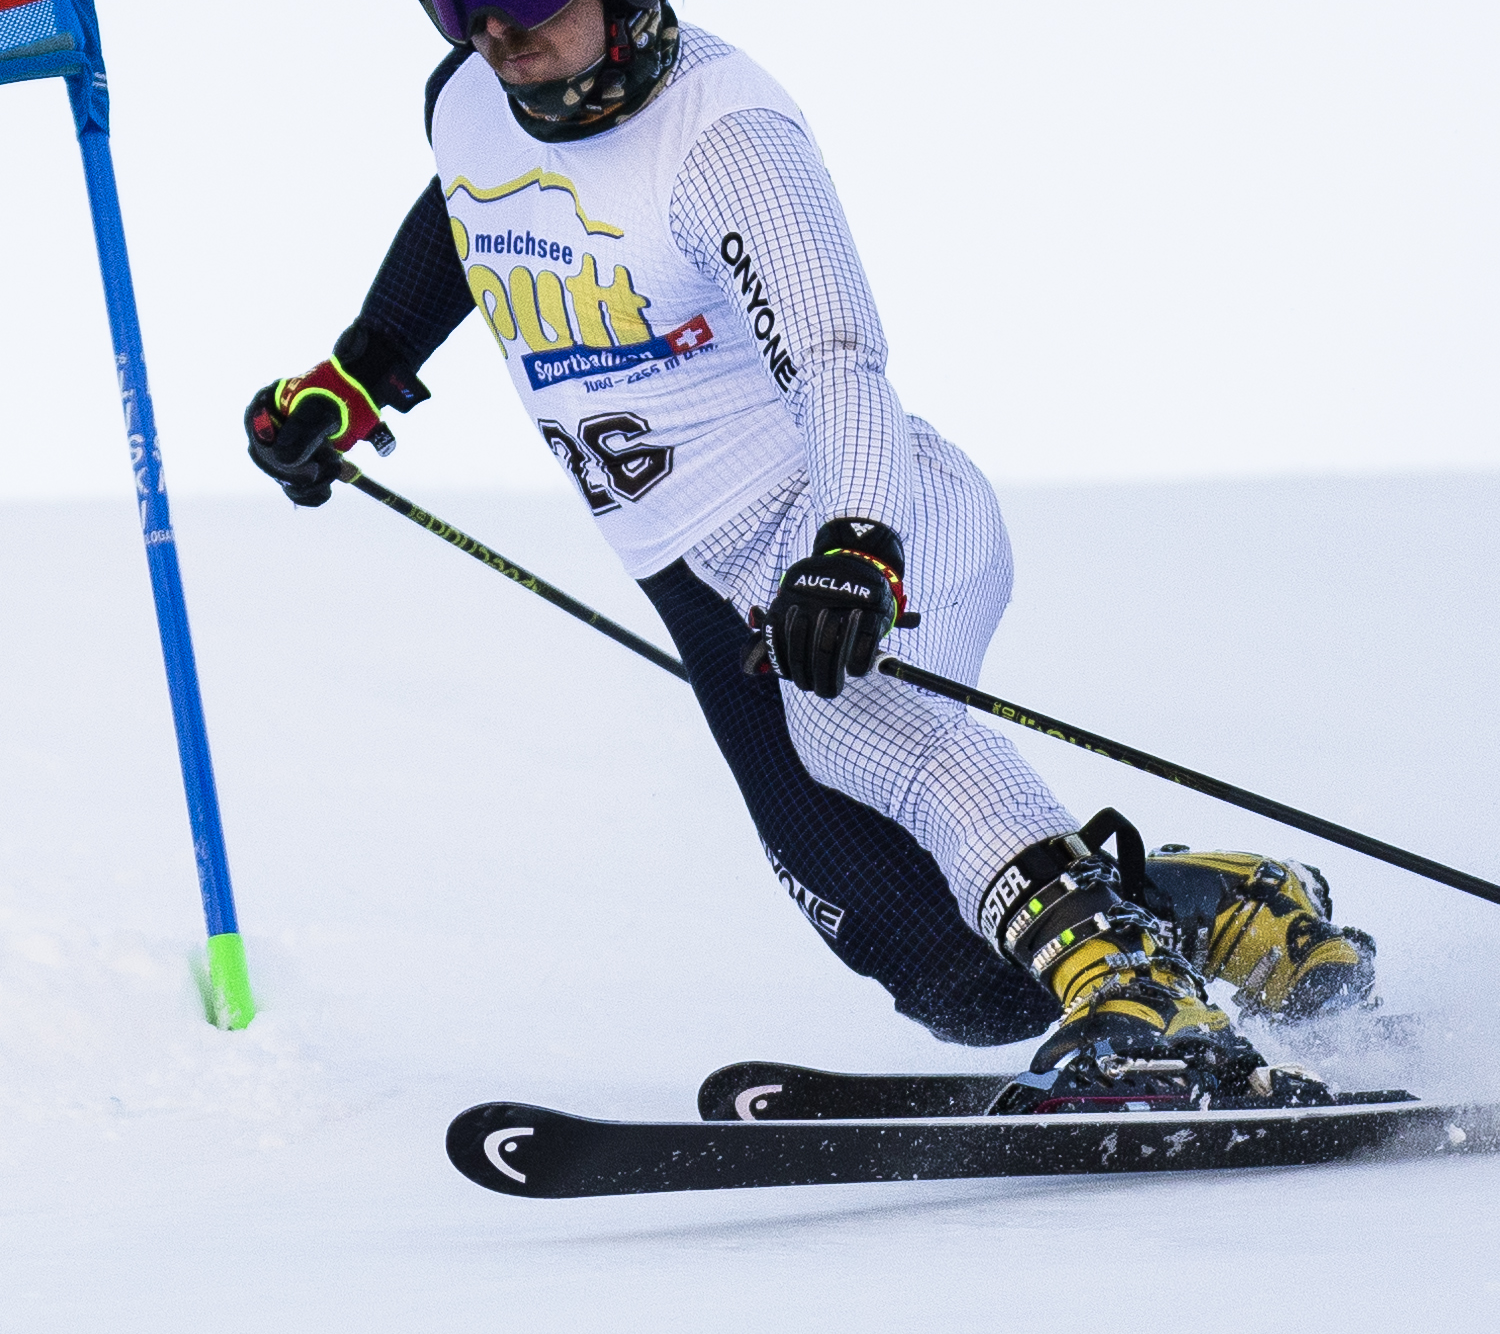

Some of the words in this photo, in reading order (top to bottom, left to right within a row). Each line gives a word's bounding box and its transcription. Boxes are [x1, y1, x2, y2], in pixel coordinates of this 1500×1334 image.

[474, 229, 574, 266] melchsee
[537, 410, 675, 517] 26
[794, 574, 871, 599] AUCLAIR
[765, 624, 784, 676] AUCLAIR
